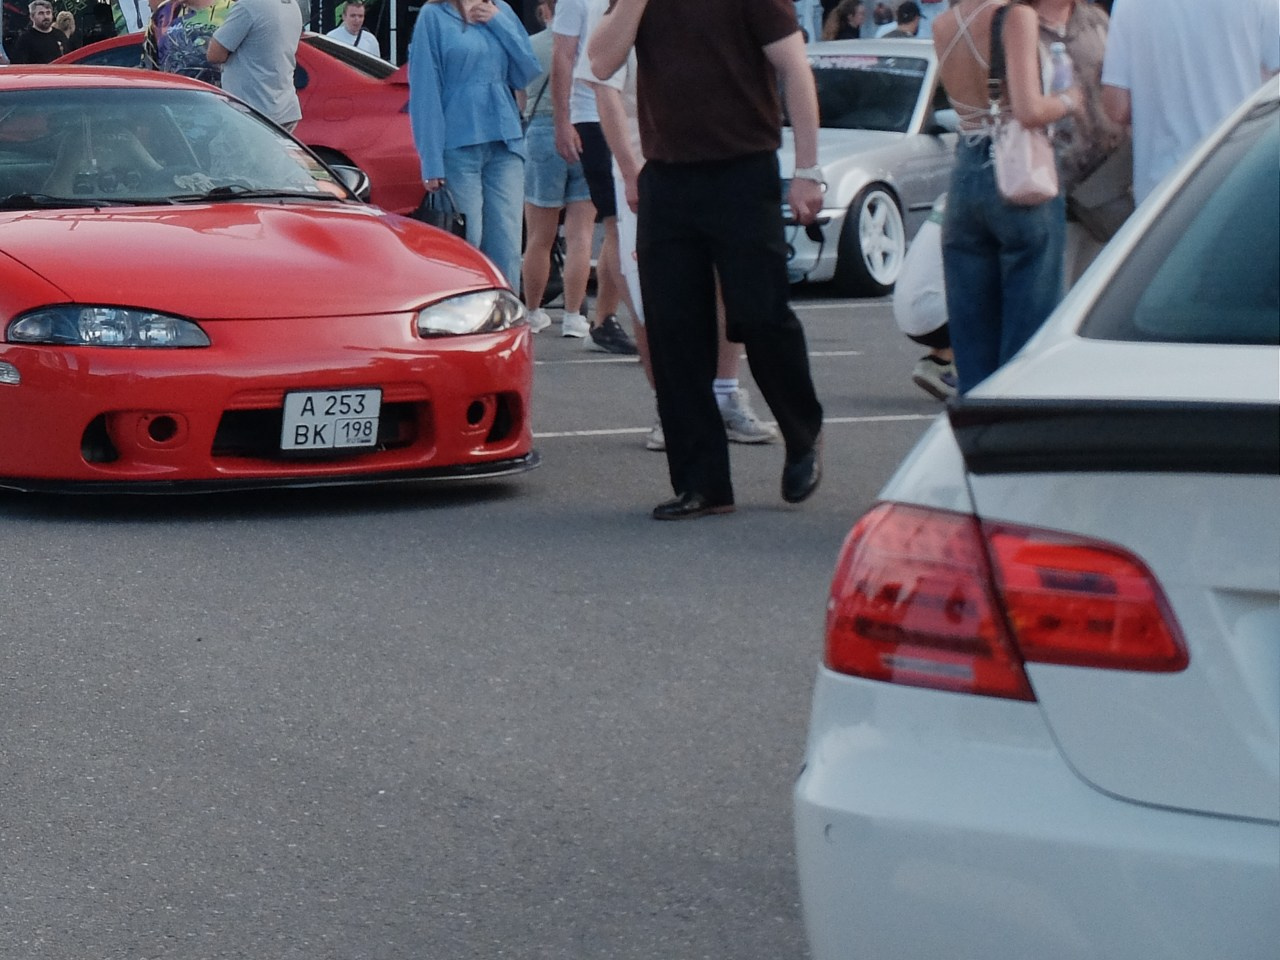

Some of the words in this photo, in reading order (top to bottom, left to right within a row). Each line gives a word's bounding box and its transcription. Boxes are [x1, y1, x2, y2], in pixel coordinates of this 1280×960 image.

[300, 396, 315, 417] A
[324, 394, 367, 416] 253
[294, 424, 328, 445] BK
[341, 420, 373, 438] 198
